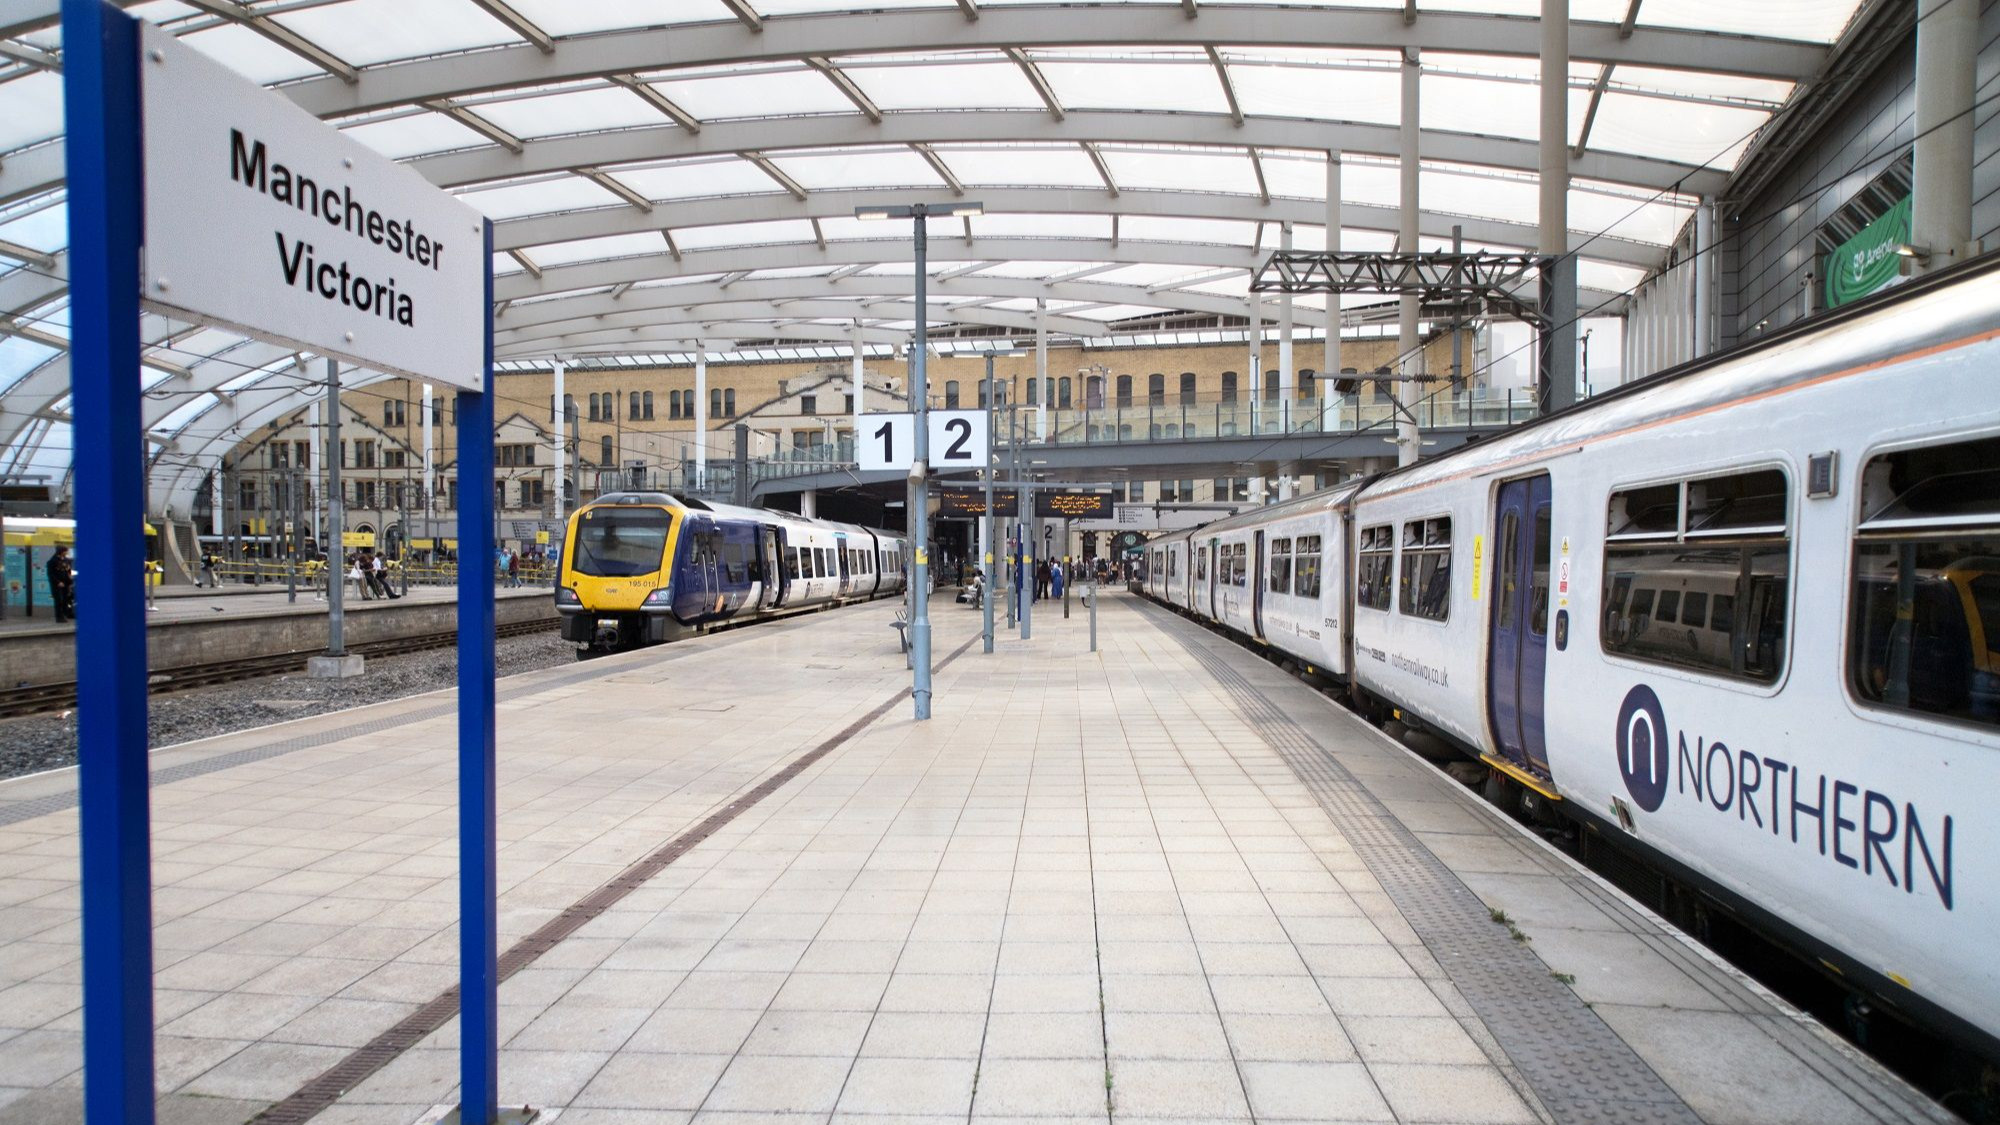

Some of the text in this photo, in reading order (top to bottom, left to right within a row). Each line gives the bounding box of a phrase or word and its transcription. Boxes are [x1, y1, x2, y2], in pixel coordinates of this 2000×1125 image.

[230, 128, 444, 271] Manchester
[1866, 237, 1894, 267] Arena
[274, 232, 415, 328] Victoria
[874, 421, 893, 463] 1
[944, 418, 972, 460] 2
[1045, 525, 1053, 539] 2
[1325, 617, 1337, 629] 57212
[1391, 651, 1449, 688] northernrailway.co.uk
[1678, 729, 1954, 911] NORTHERN
